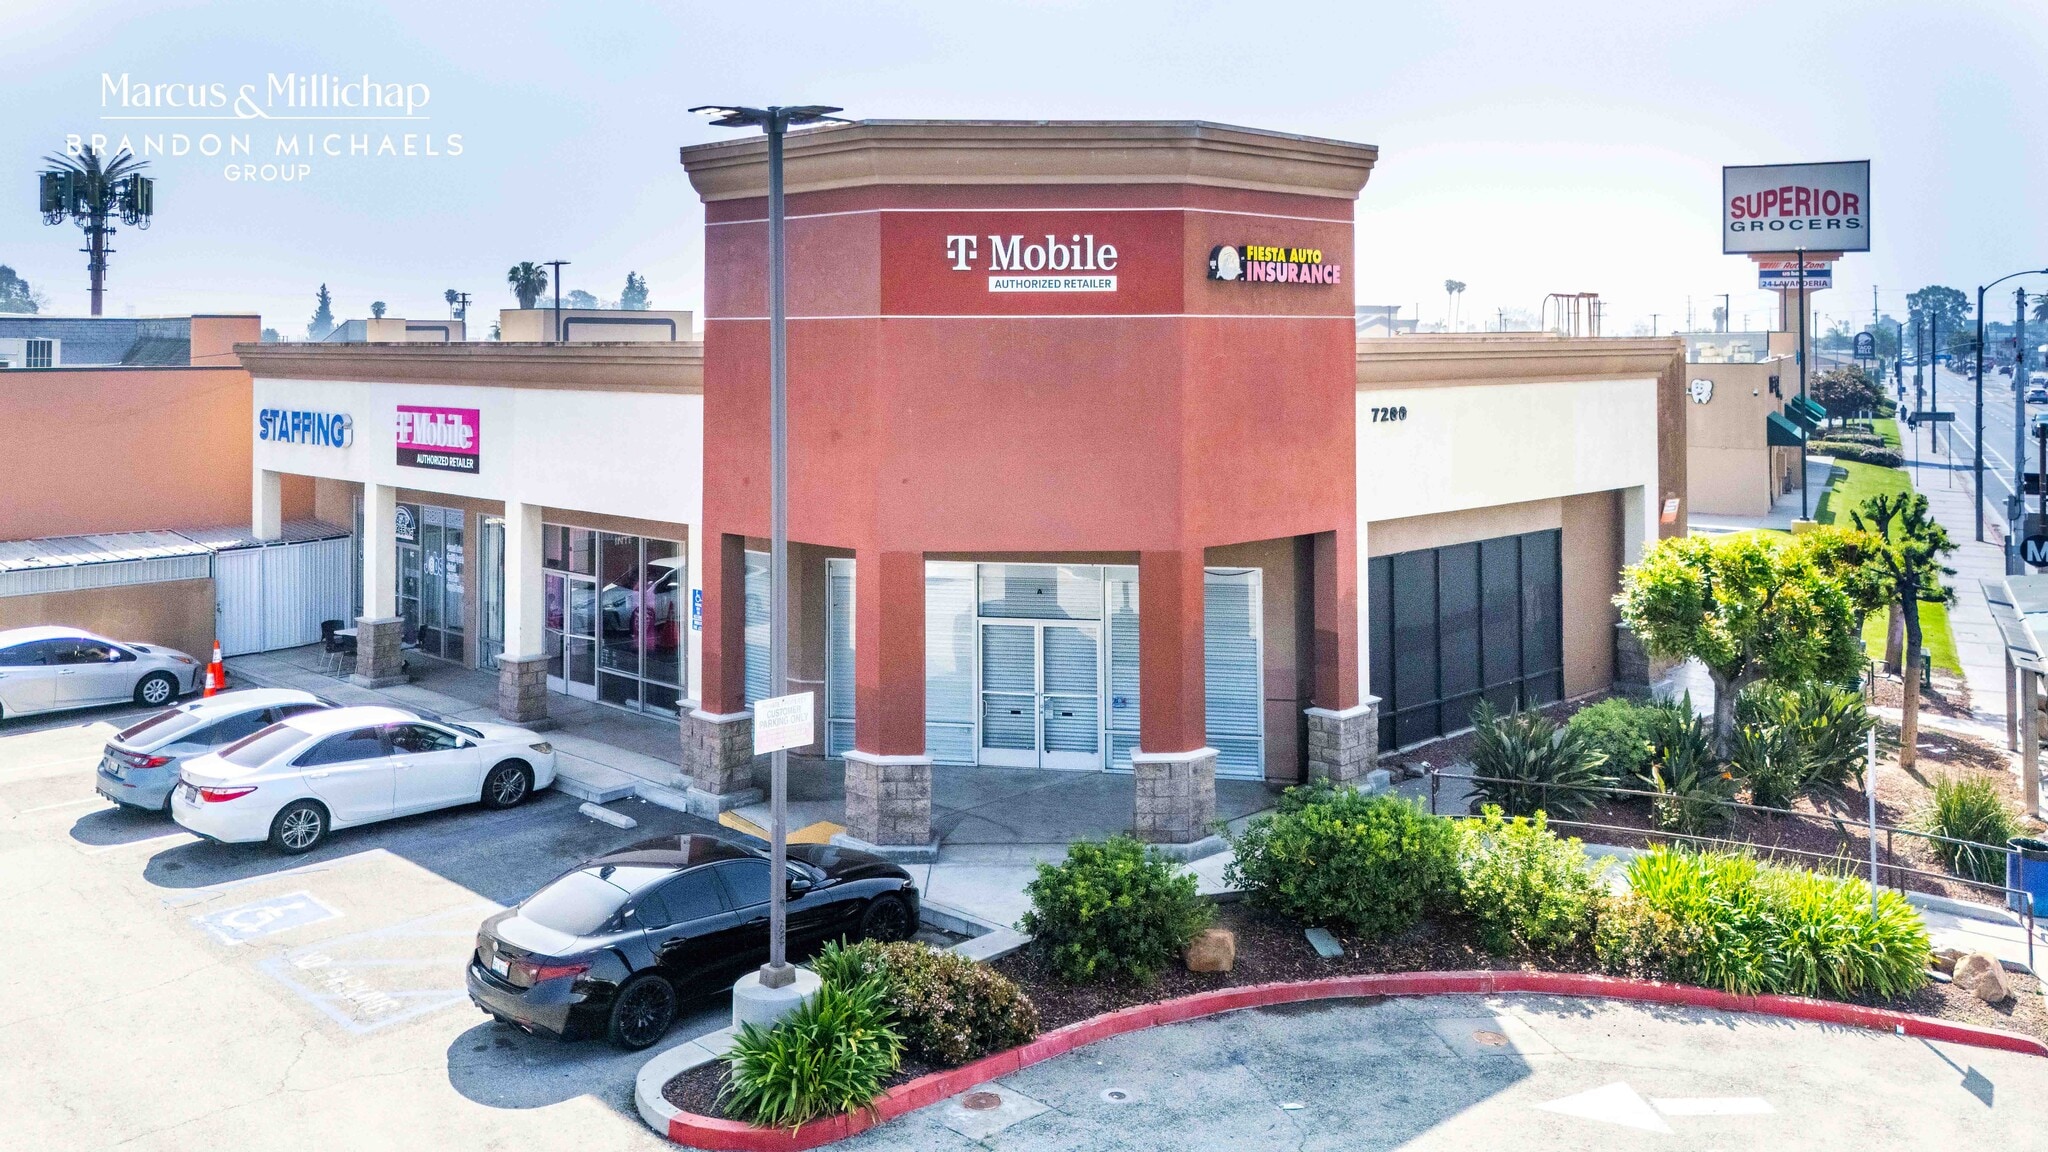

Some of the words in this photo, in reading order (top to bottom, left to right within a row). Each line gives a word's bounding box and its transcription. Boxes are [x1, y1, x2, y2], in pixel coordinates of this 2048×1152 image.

[1731, 186, 1859, 220] SUPERIOR
[987, 234, 1118, 271] Mobile
[1246, 245, 1287, 263] FIESTA
[1289, 248, 1322, 263] AUTO
[994, 279, 1062, 290] AUTHORIZED
[1063, 279, 1112, 289] RETAILER
[1246, 261, 1341, 285] INSURANCE
[259, 408, 354, 449] STAFFING
[411, 412, 474, 449] Mobile
[416, 453, 449, 466] AUTHORIZED
[449, 456, 474, 469] RETAILER
